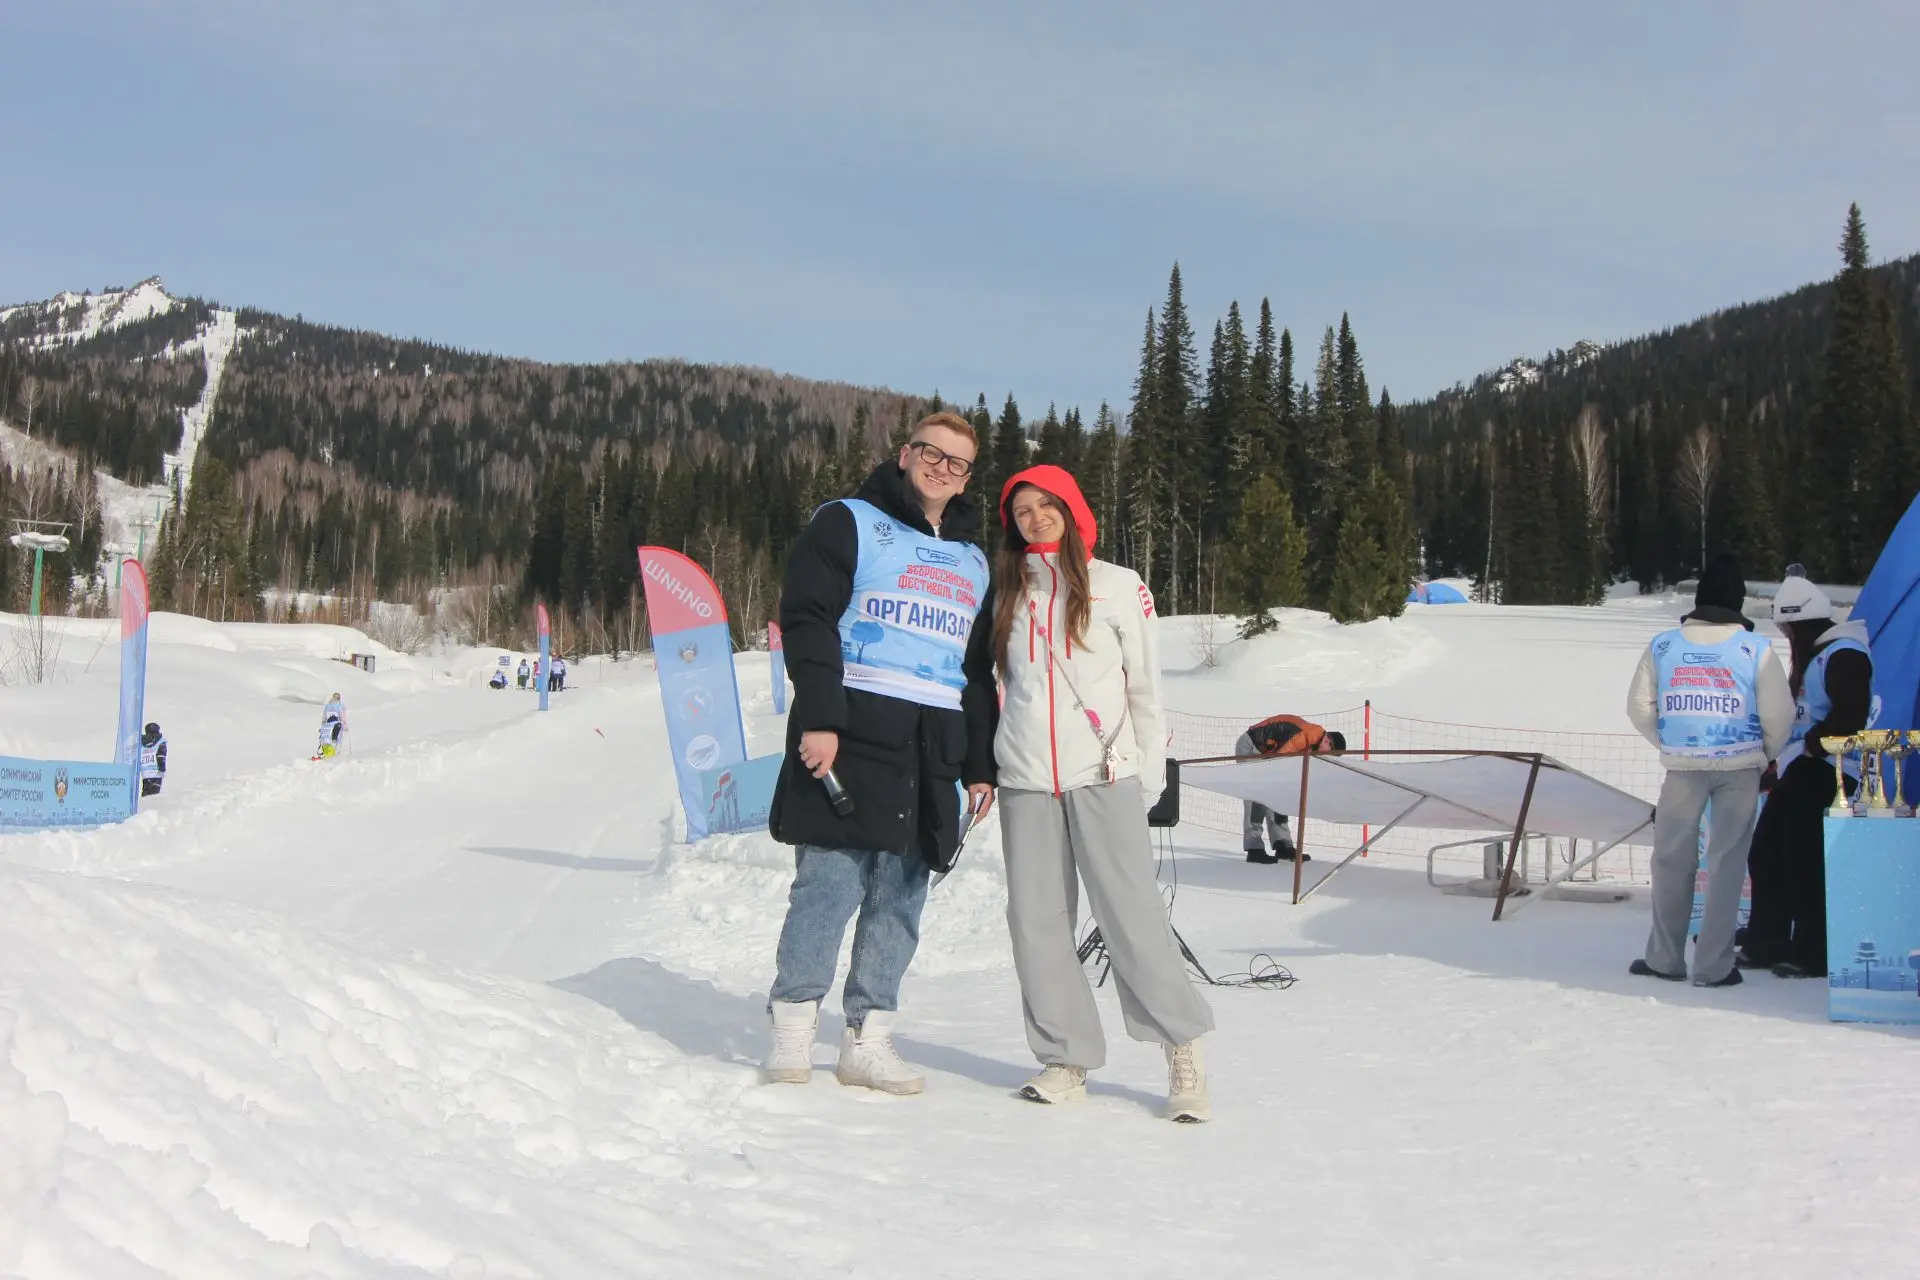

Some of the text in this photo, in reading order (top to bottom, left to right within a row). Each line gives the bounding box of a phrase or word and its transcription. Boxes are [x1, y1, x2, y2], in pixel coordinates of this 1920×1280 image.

[898, 575, 953, 600] ФЕСТИВАЛЬ
[866, 597, 973, 642] ОРГАНИЗАТ
[1666, 694, 1740, 714] ВОЛОНТЁР
[1, 767, 42, 783] ОЛИМПИЙСКИЙ
[73, 776, 127, 787] МИНИСТЕРСТВО СПОРТА
[22, 789, 44, 802] РОССИИ
[91, 790, 109, 800] РОССИИ
